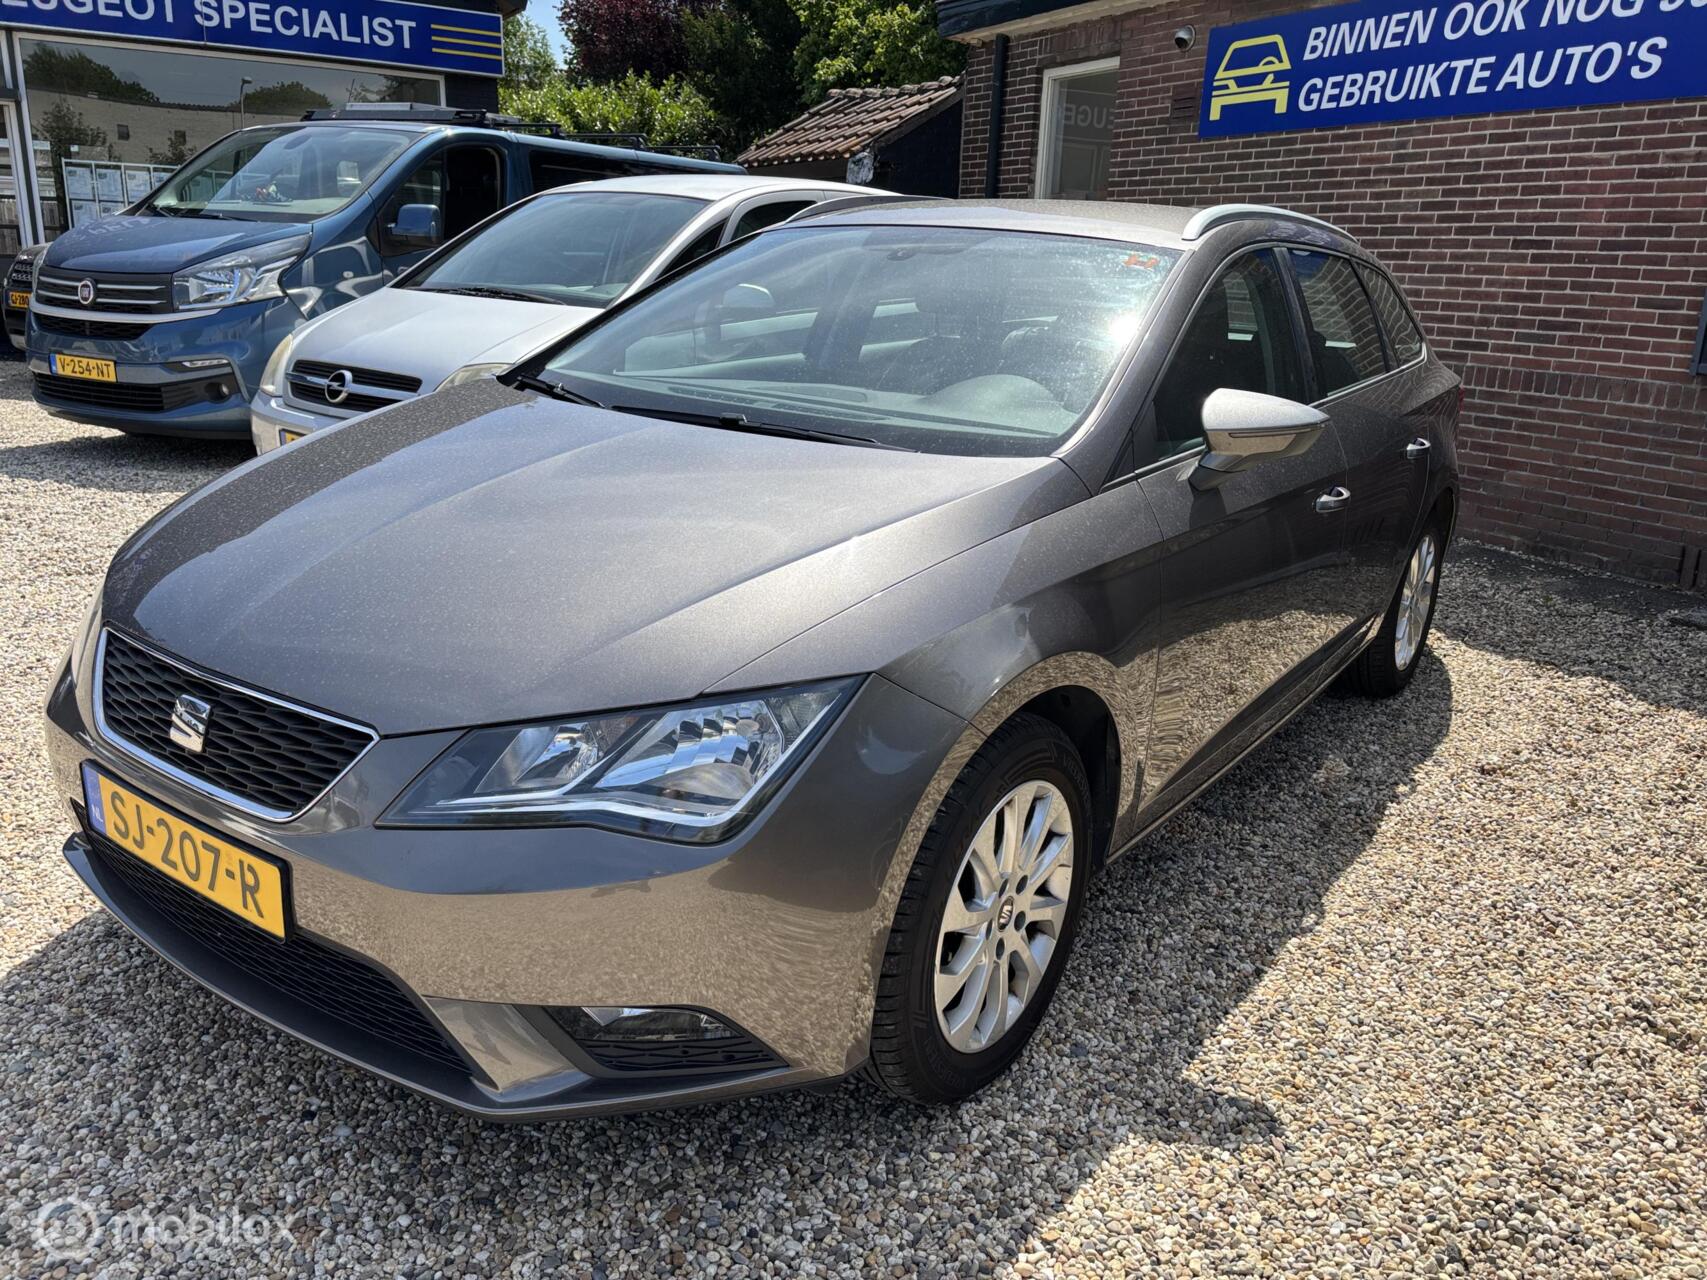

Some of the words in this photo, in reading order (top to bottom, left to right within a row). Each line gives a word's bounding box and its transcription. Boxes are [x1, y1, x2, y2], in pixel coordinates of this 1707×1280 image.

[193, 0, 417, 49] SPECIALIST
[1302, 7, 1438, 61] BINNEN
[1443, 0, 1529, 41] OOK
[1297, 55, 1497, 112] GEBRUIKTE
[1494, 36, 1668, 92] AUTO'S
[58, 357, 111, 379] V-254-NT
[110, 790, 265, 920] SJ-207-R
